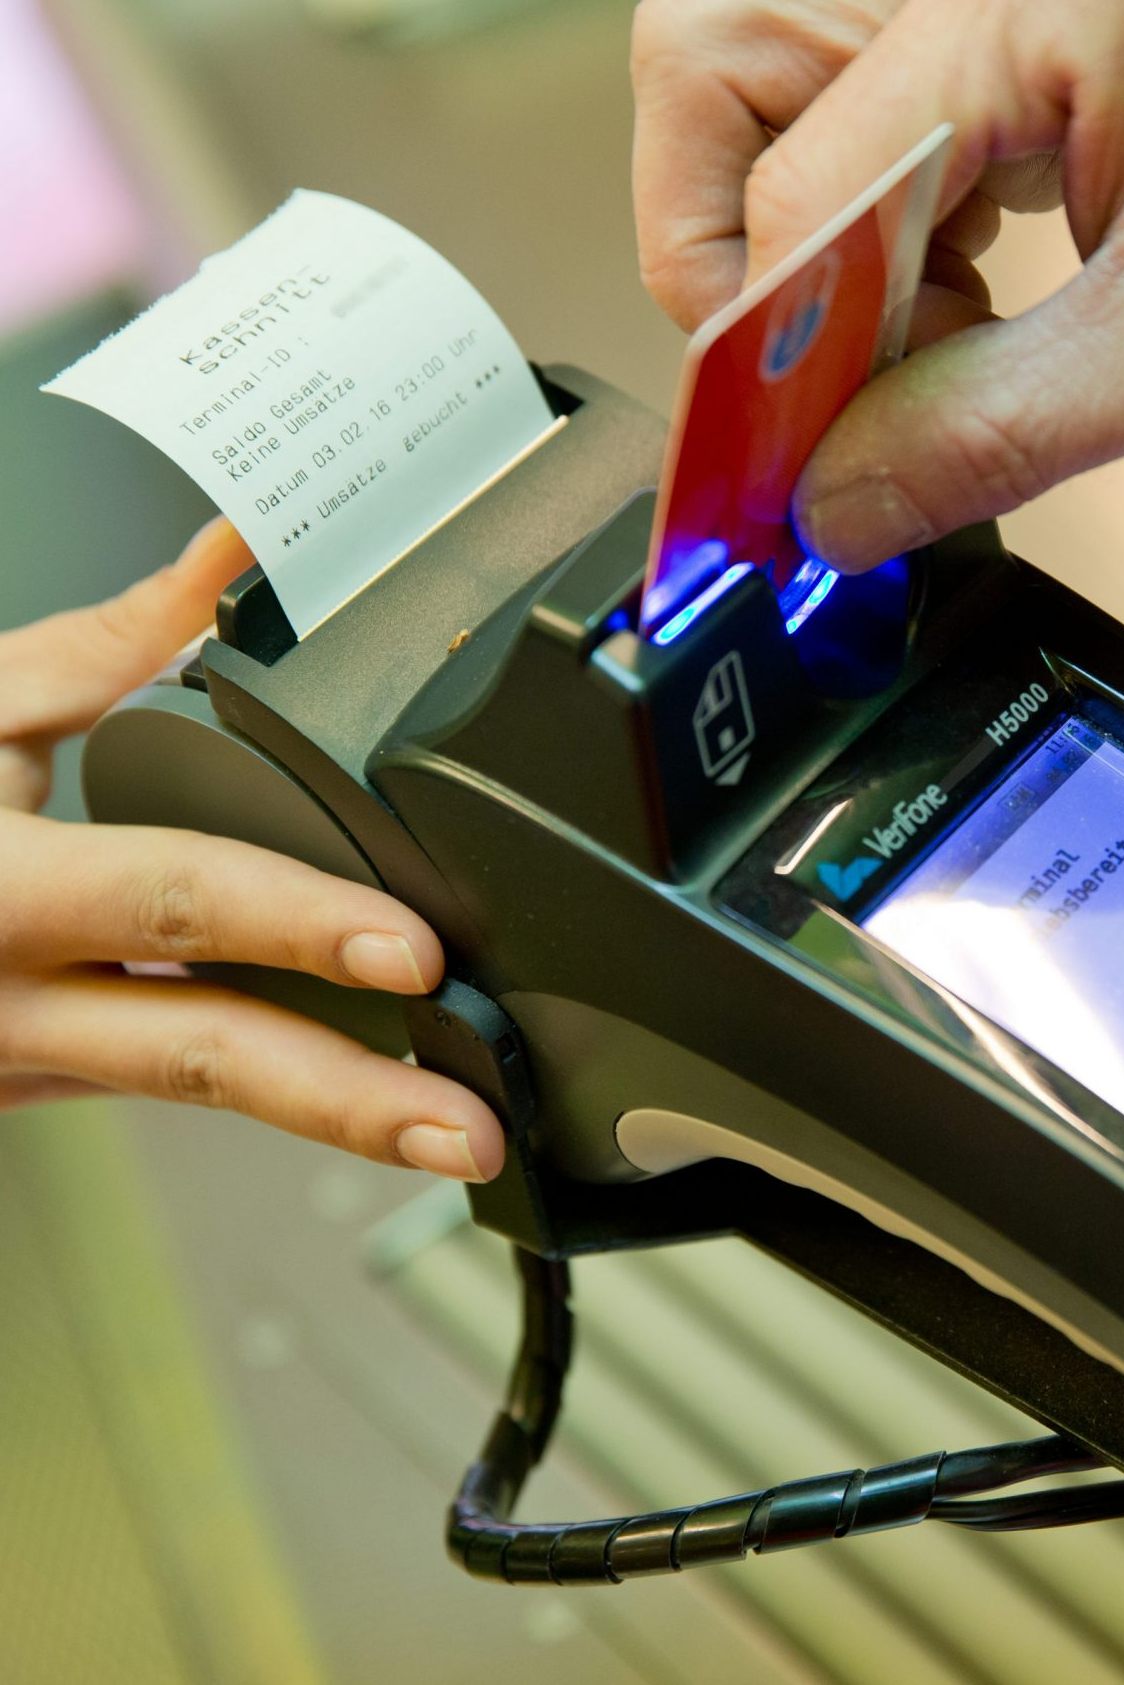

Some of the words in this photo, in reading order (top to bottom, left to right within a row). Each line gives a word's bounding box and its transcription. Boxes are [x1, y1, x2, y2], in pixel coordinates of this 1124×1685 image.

[179, 348, 291, 435] Terminal-ID
[212, 421, 266, 465] Saldo
[269, 370, 332, 419] Gesamt
[402, 392, 468, 452] gebucht
[227, 437, 281, 482] Keine
[255, 469, 309, 515] Datum
[312, 400, 391, 468] 03.02.16
[395, 355, 446, 401] 23:00
[985, 683, 1049, 746] H5000
[862, 784, 948, 859] VeriFone
